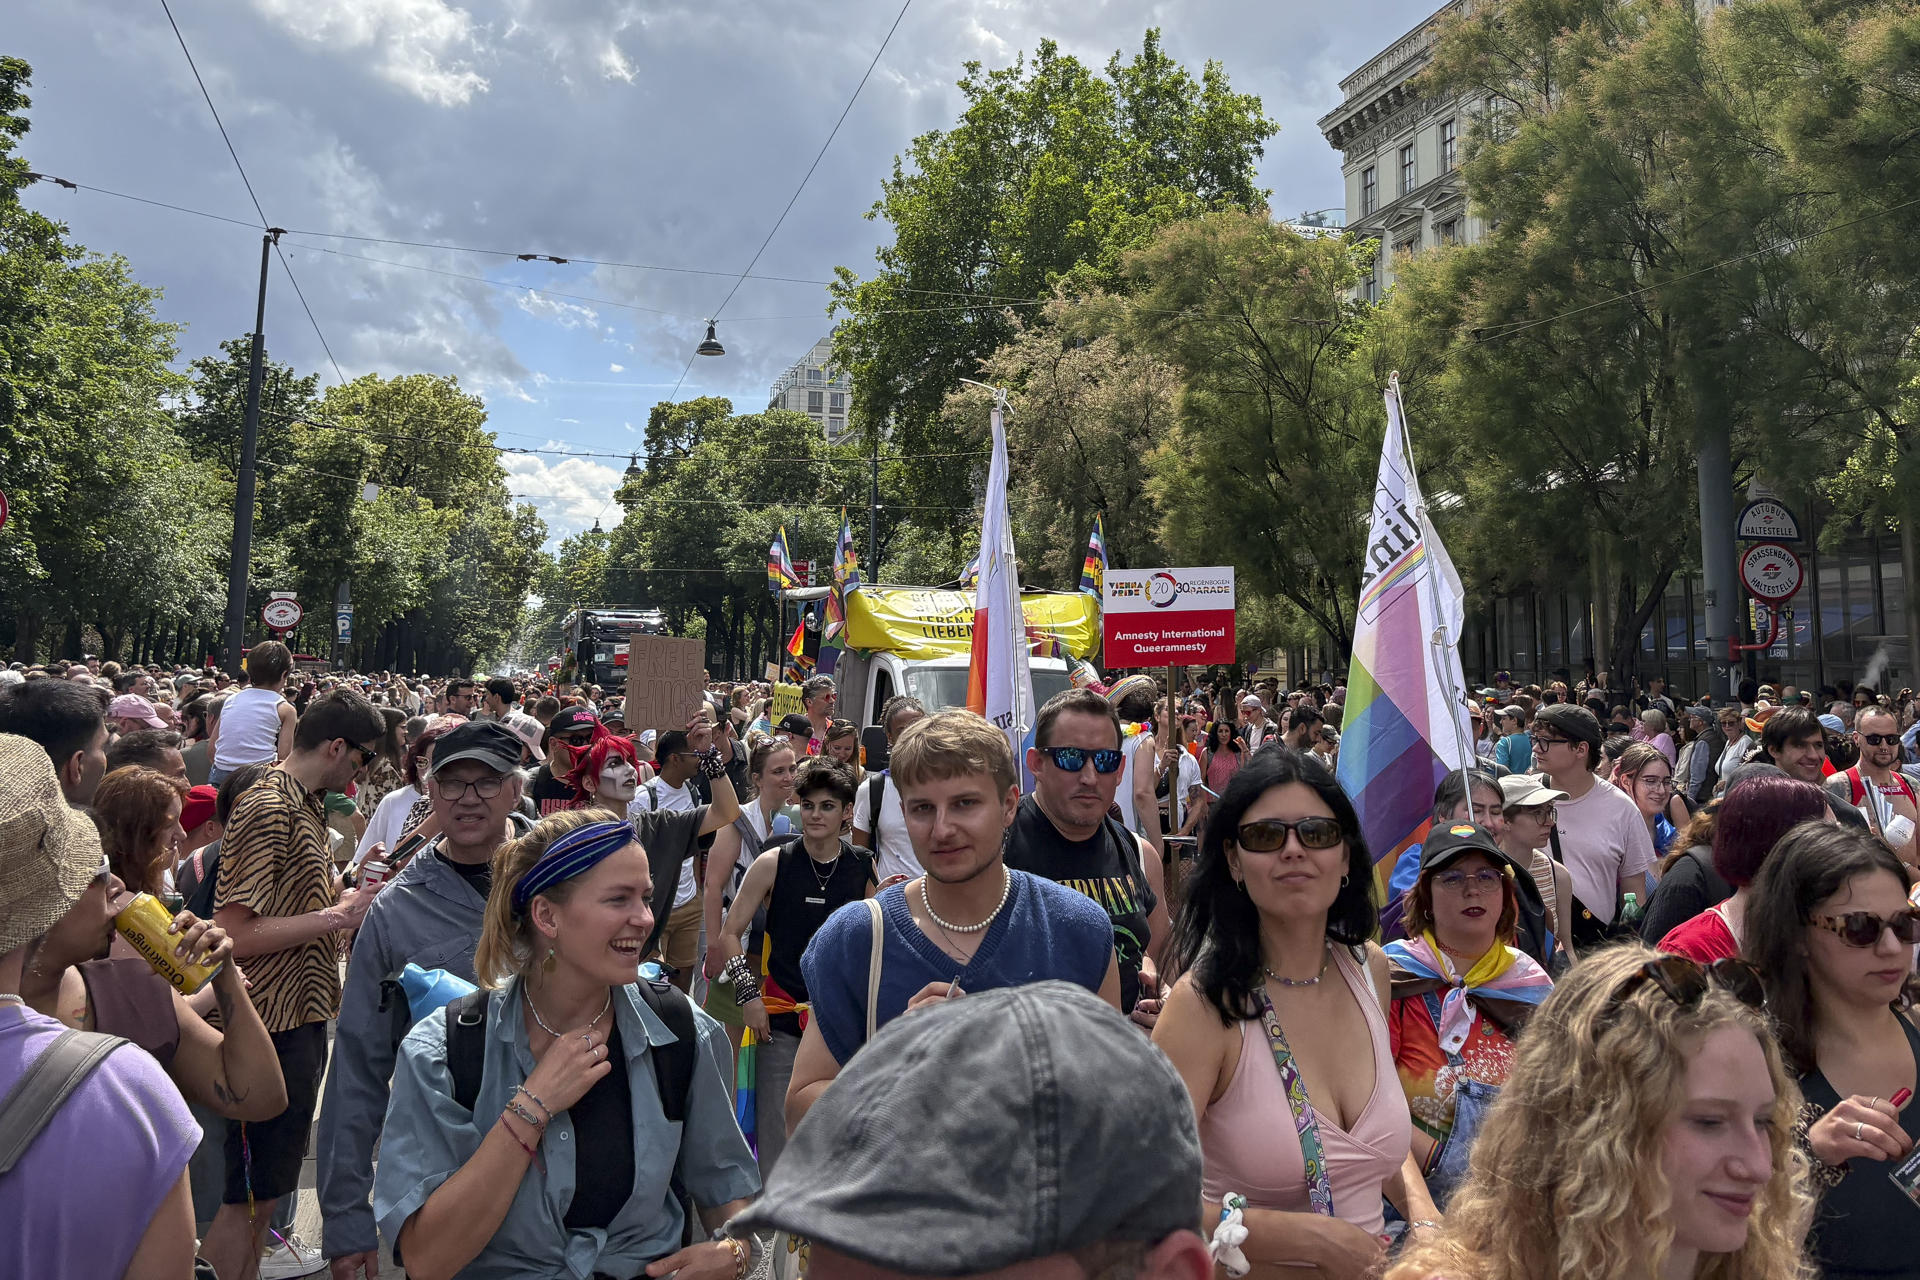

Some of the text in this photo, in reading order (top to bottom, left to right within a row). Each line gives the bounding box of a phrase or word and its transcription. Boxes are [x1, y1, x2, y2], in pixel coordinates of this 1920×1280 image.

[1751, 504, 1786, 520] AUTOBUS
[1745, 526, 1793, 536] HALTESTELLE
[1747, 549, 1795, 569] STRASSENBAHN
[1108, 581, 1144, 589] VIENNA
[1190, 586, 1230, 595] PARADE
[1751, 577, 1795, 595] HALTESTELLE
[1111, 589, 1140, 597] PRIDE
[922, 624, 974, 639] LIEBEN
[1114, 626, 1225, 641] Amnesty International
[1133, 642, 1207, 654] Queeramnesty
[633, 639, 698, 680] FREE
[630, 679, 703, 728] HUGS
[122, 927, 185, 987] Ottakringer
